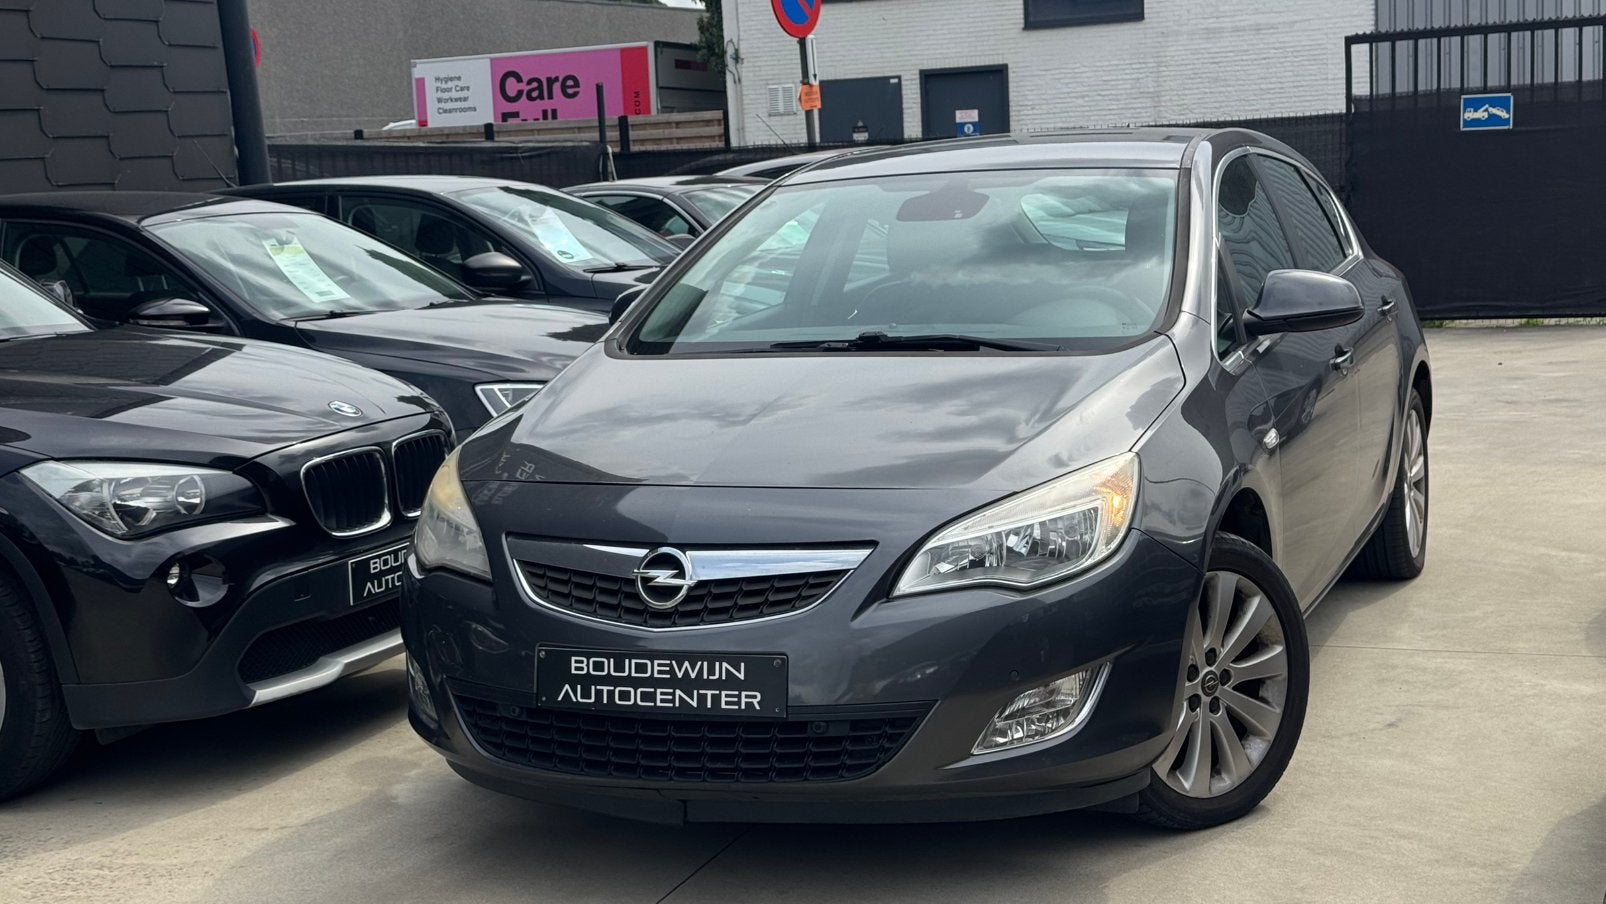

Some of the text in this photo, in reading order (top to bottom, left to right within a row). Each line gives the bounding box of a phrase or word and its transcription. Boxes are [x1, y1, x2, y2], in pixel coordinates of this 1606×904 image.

[434, 76, 462, 85] Hygiene
[436, 84, 471, 94] Floor Care
[499, 70, 581, 104] Care
[436, 95, 470, 104] Workwear
[437, 106, 478, 115] Cleanrooms
[570, 656, 746, 680] BOUDEWIJN
[557, 684, 762, 710] AUTOCENTER
